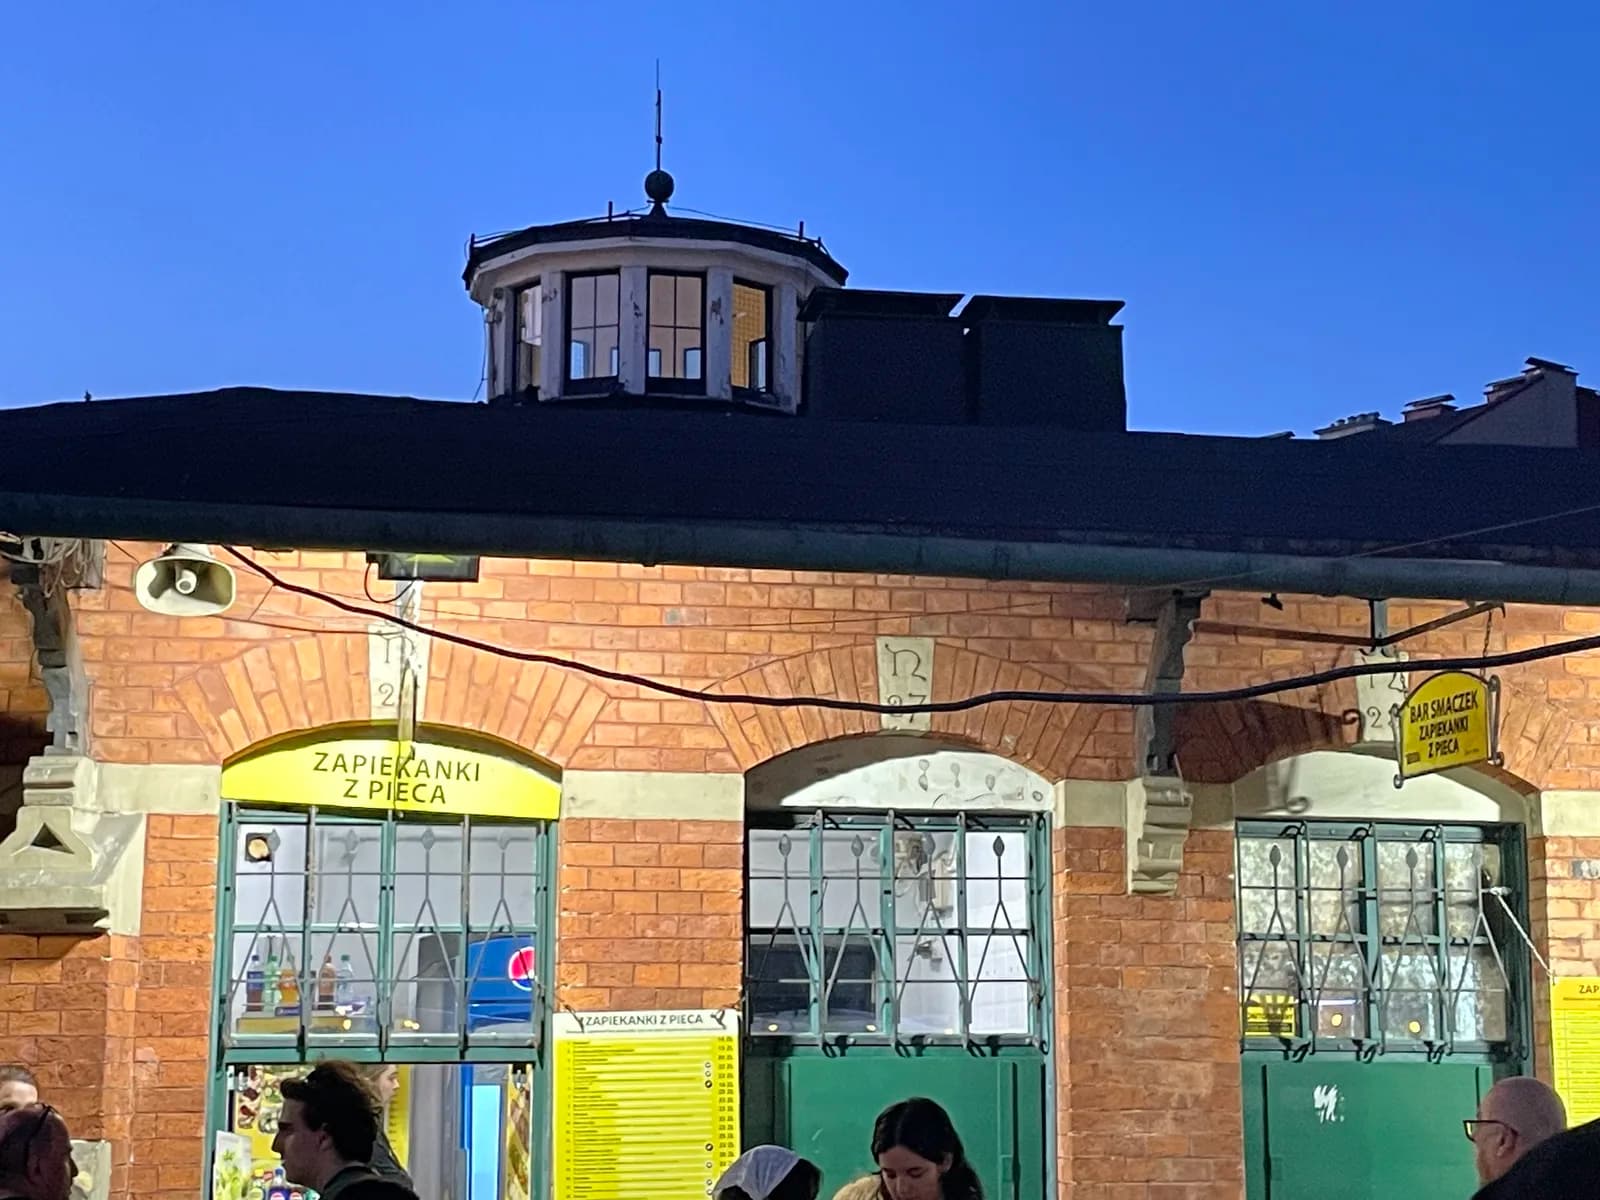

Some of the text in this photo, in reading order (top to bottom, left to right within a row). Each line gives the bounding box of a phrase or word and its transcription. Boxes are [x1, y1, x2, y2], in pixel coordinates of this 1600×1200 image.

[1410, 689, 1479, 723] BAR SMACZEK
[1419, 715, 1469, 741] ZAPIEKANKI
[1428, 742, 1435, 759] Z
[1435, 738, 1460, 756] PIECA
[313, 752, 480, 781] ZAPIEKANKI
[343, 779, 446, 804] Z PIECA
[585, 1014, 703, 1026] ZAPIEKANKI Z PIECA
